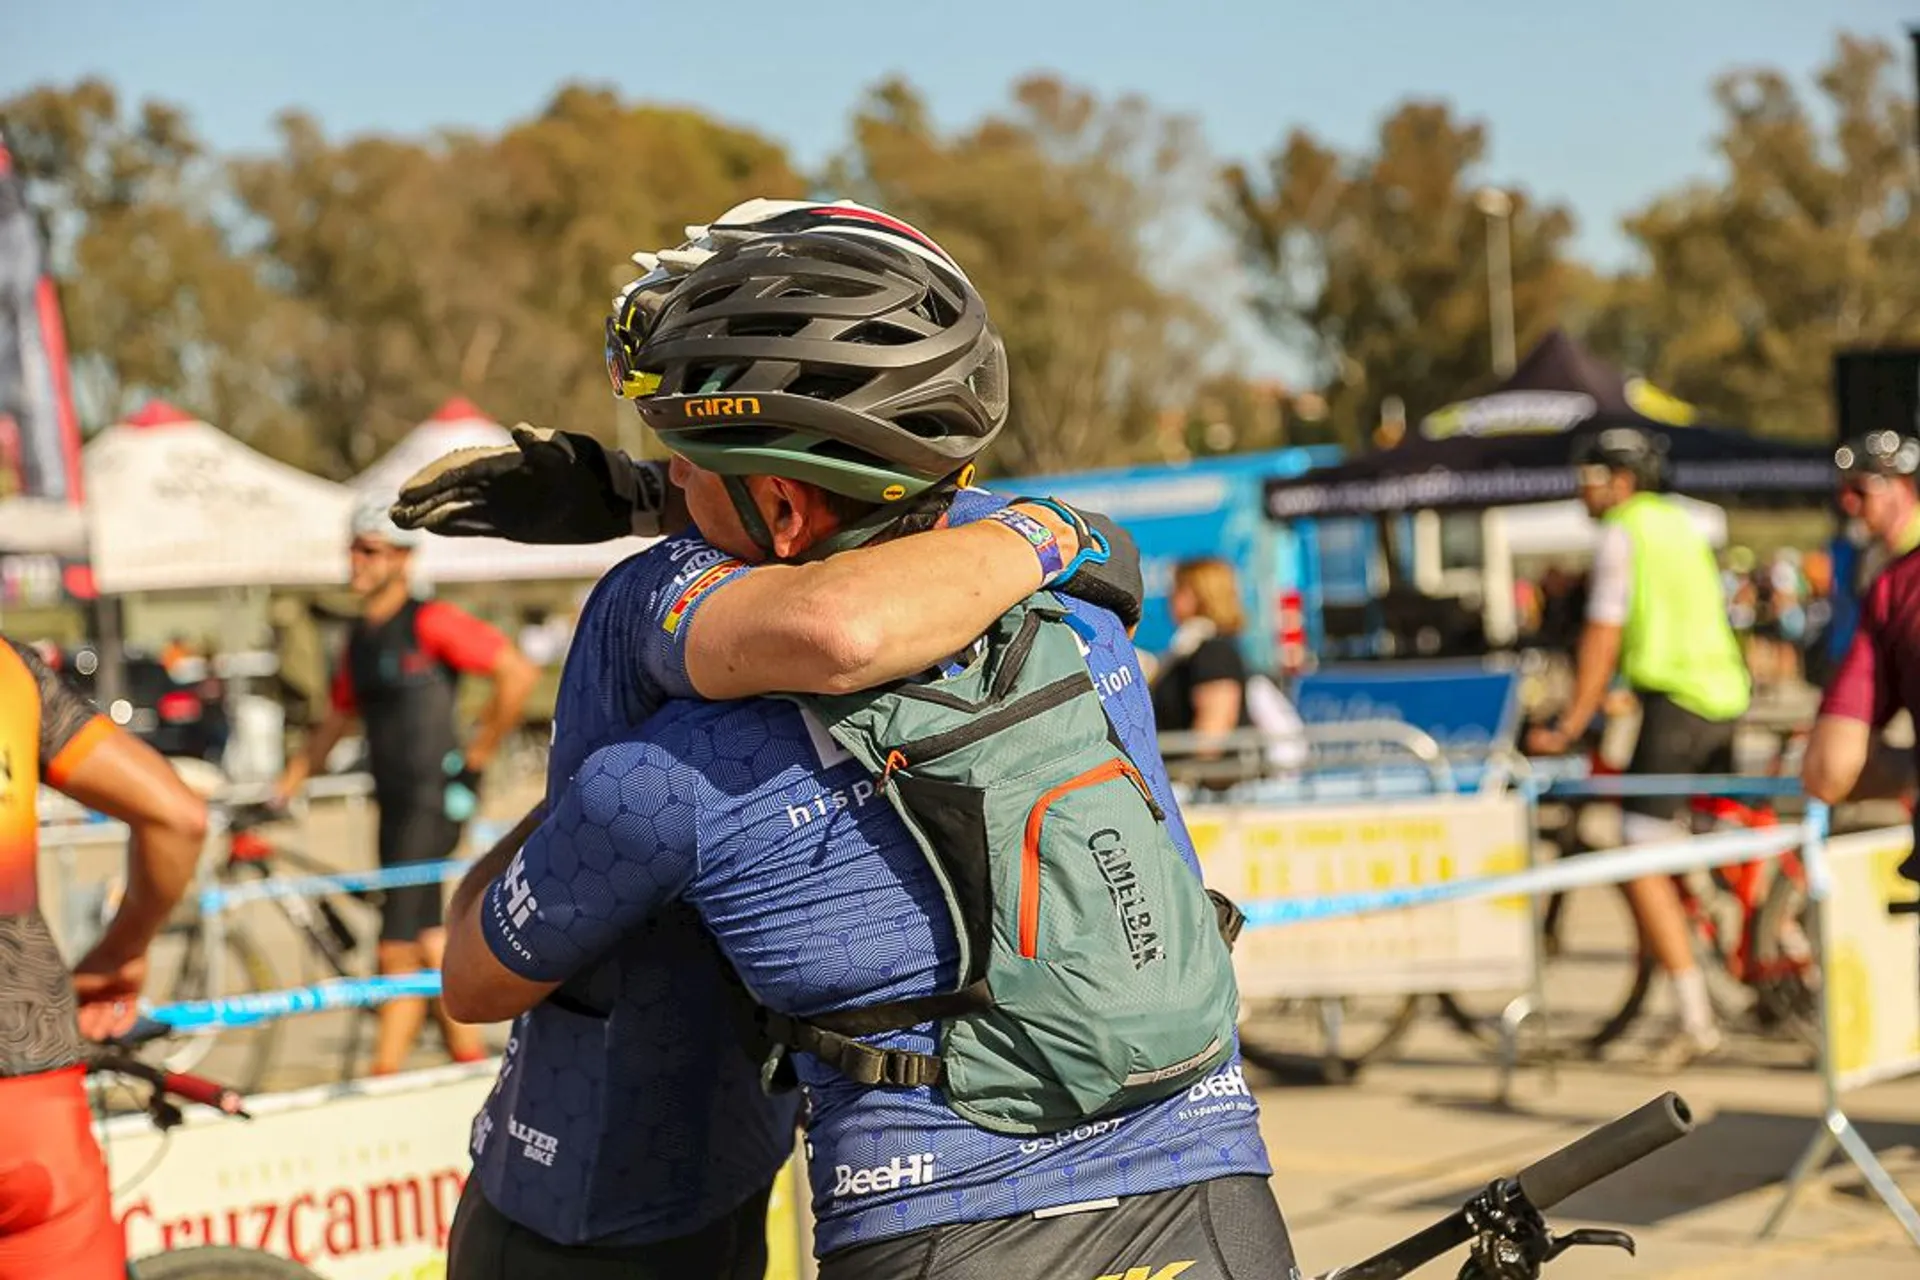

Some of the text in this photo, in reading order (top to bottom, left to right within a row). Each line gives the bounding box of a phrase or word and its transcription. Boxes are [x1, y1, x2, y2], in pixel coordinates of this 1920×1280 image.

[684, 397, 761, 418] GIRO
[1088, 828, 1167, 971] CAMELBAK
[523, 1144, 556, 1167] BIKE
[833, 1152, 936, 1197] BeeHi
